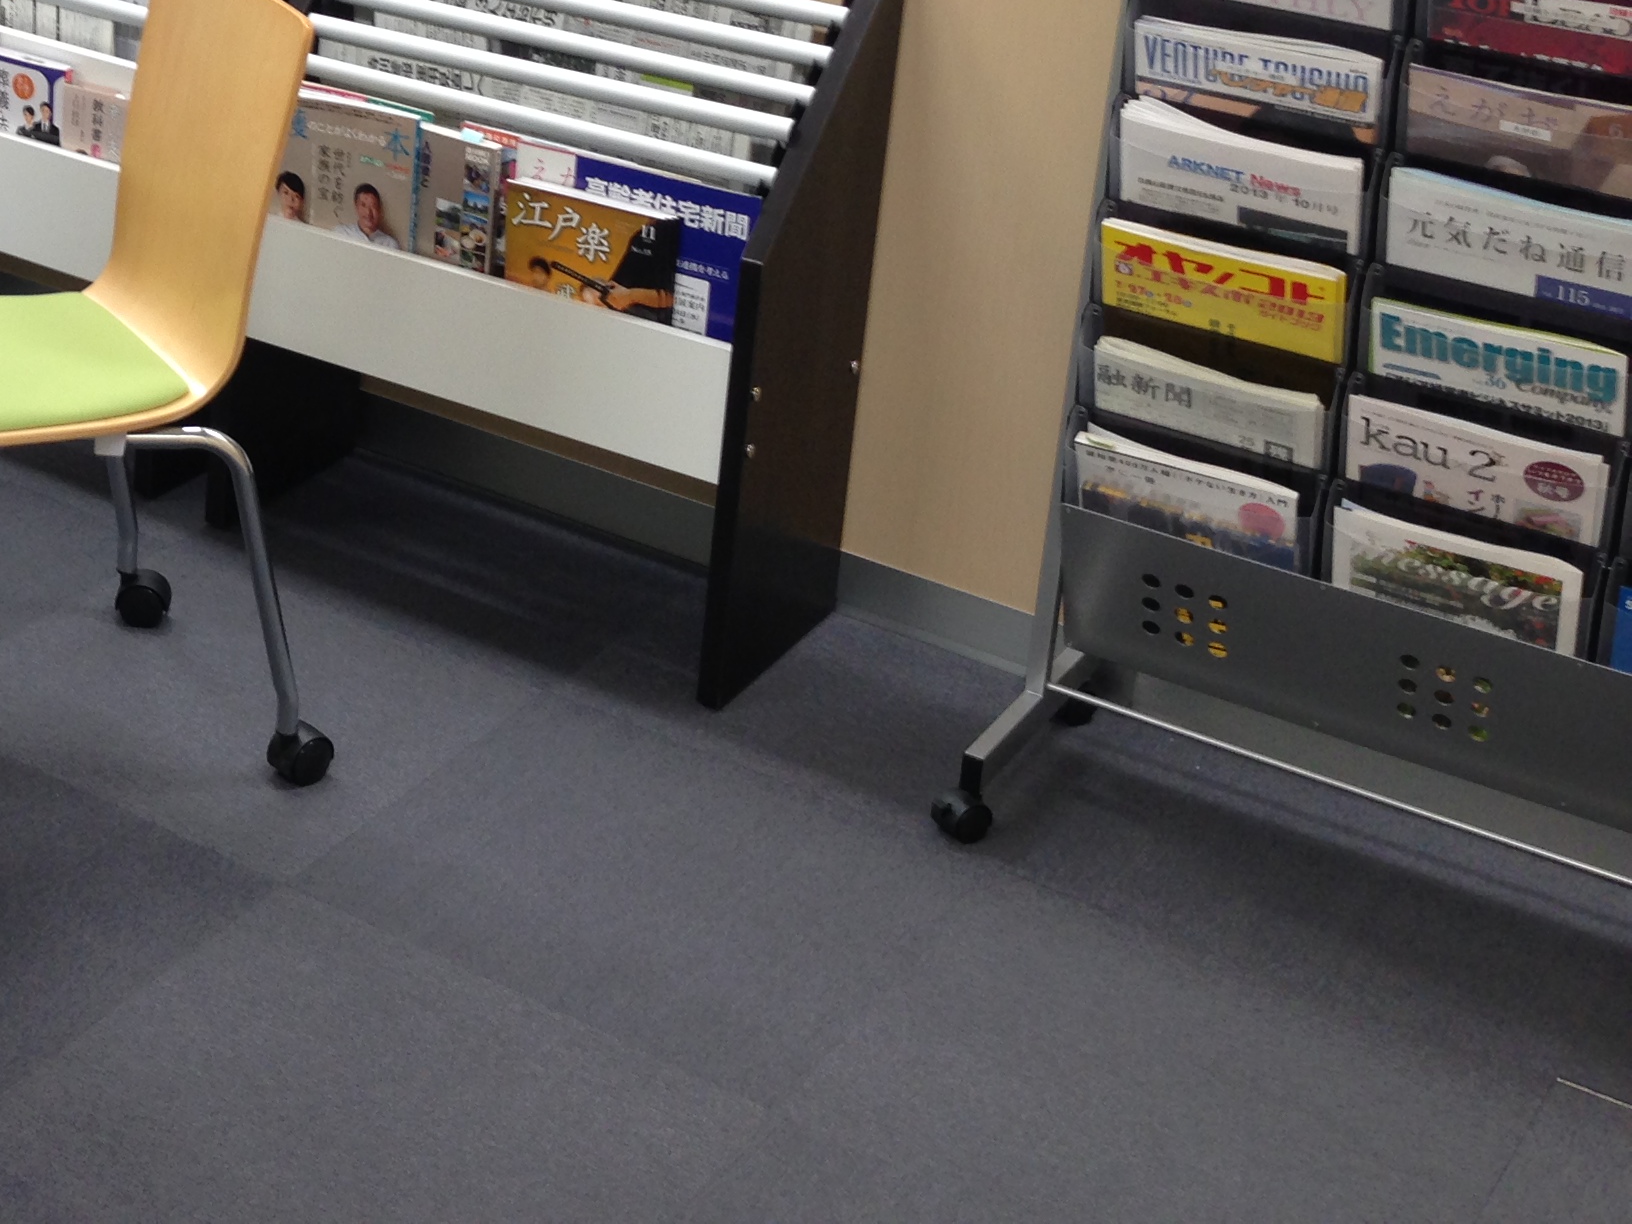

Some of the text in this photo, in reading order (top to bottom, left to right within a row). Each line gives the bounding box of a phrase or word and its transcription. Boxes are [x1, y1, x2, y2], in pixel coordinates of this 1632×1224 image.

[584, 176, 751, 241] 高齢者住宅新聞
[1167, 154, 1246, 182] ARKNET
[1248, 174, 1302, 198] News
[511, 192, 611, 263] 江戸楽
[1407, 211, 1627, 282] 元気だね通信
[1556, 285, 1590, 307] 115
[1379, 312, 1617, 404] Emerging
[1359, 415, 1451, 471] kau
